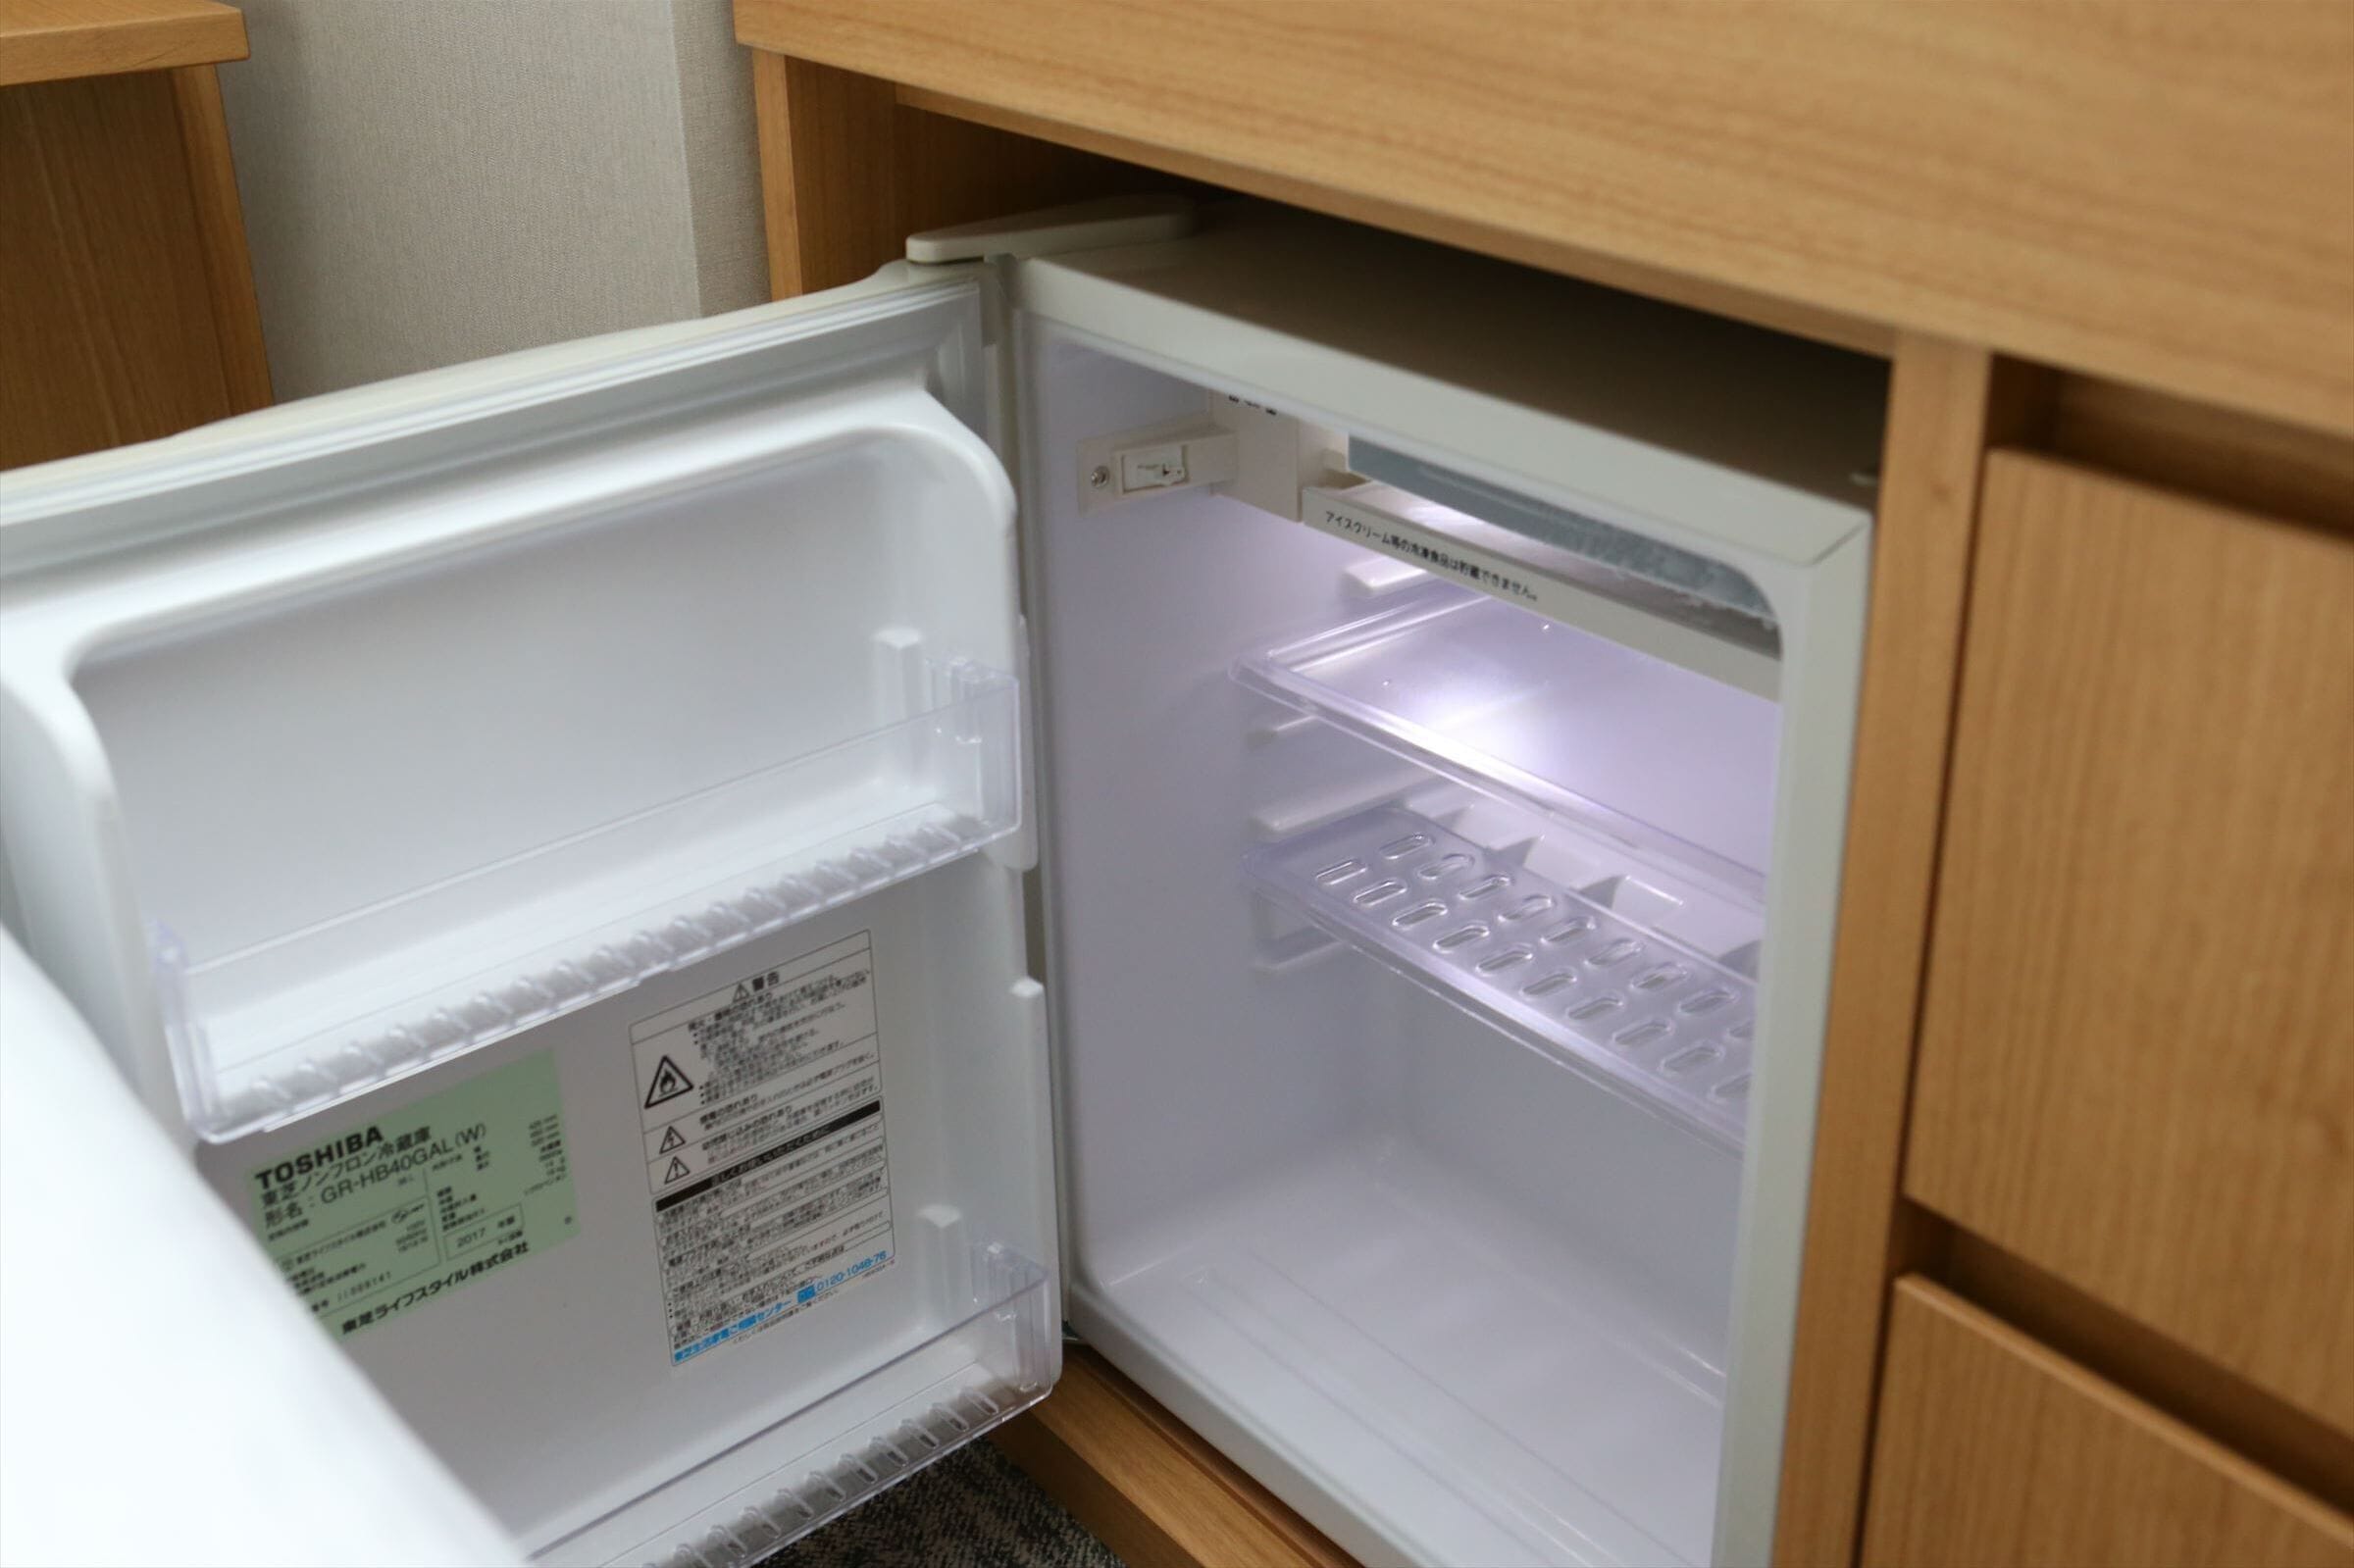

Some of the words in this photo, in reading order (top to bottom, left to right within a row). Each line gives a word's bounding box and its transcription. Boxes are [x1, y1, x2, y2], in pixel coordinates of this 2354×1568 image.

[752, 971, 780, 992] 警告
[255, 1126, 384, 1190] TOSHIBA
[261, 1126, 432, 1206] 東芝ノンフロン冷蔵庫
[456, 1228, 486, 1248] 2017
[342, 1240, 529, 1335] 東芝ライフスタイル株式会社
